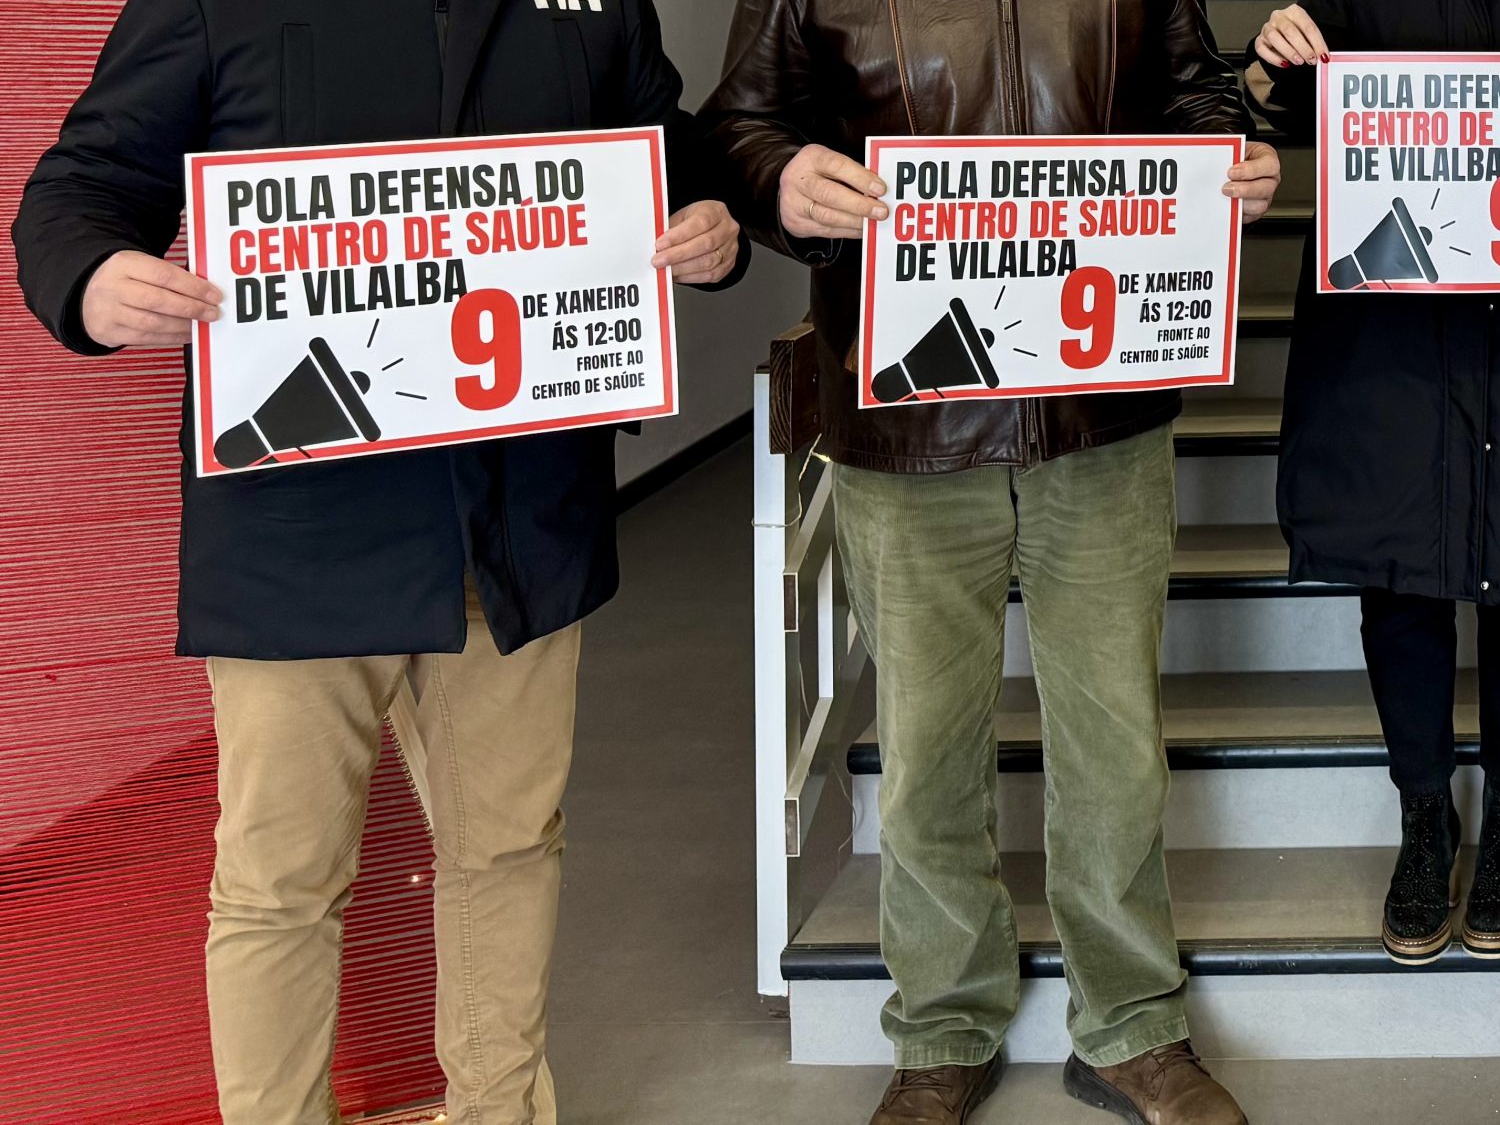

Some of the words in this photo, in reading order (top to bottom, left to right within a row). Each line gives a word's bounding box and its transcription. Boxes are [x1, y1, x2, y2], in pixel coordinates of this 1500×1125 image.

[1344, 75, 1413, 108] POLA
[1344, 112, 1448, 145] CENTRO
[1460, 112, 1492, 145] DE
[896, 161, 978, 199] POLA
[991, 160, 1126, 198] DEFENSA
[1139, 159, 1177, 195] DO
[1346, 148, 1379, 181] DE
[228, 175, 335, 226] POLA
[351, 163, 521, 216] DEFENSA
[536, 159, 583, 202] DO
[895, 202, 1017, 242] CENTRO
[1030, 201, 1067, 238] DE
[1079, 191, 1176, 237] SAÚDE
[230, 220, 387, 276] CENTRO
[404, 215, 452, 260] DE
[466, 198, 587, 254] SAÚDE
[896, 243, 936, 281] DE
[949, 240, 1076, 279] VILALBA
[236, 275, 287, 323] DE
[303, 259, 467, 316] VILALBA
[1061, 267, 1116, 369] 9
[1119, 274, 1139, 294] DE
[1145, 271, 1213, 293] XANEIRO
[1140, 298, 1161, 323] ÁS
[1167, 300, 1211, 321] 12:00
[452, 289, 522, 411] 9
[523, 294, 548, 318] DE
[556, 284, 639, 315] XANEIRO
[553, 321, 578, 350] ÁS
[585, 318, 641, 346] 12:00
[1158, 328, 1193, 342] FRONTE
[1197, 327, 1210, 339] AO
[577, 352, 622, 371] FRONTE
[627, 350, 643, 365] AO
[1120, 350, 1158, 364] CENTRO
[1162, 349, 1174, 361] DE
[1178, 344, 1209, 360] SAÚDE
[532, 381, 580, 400] CENTRO
[585, 378, 600, 393] DE
[604, 371, 646, 393] SAÚDE
